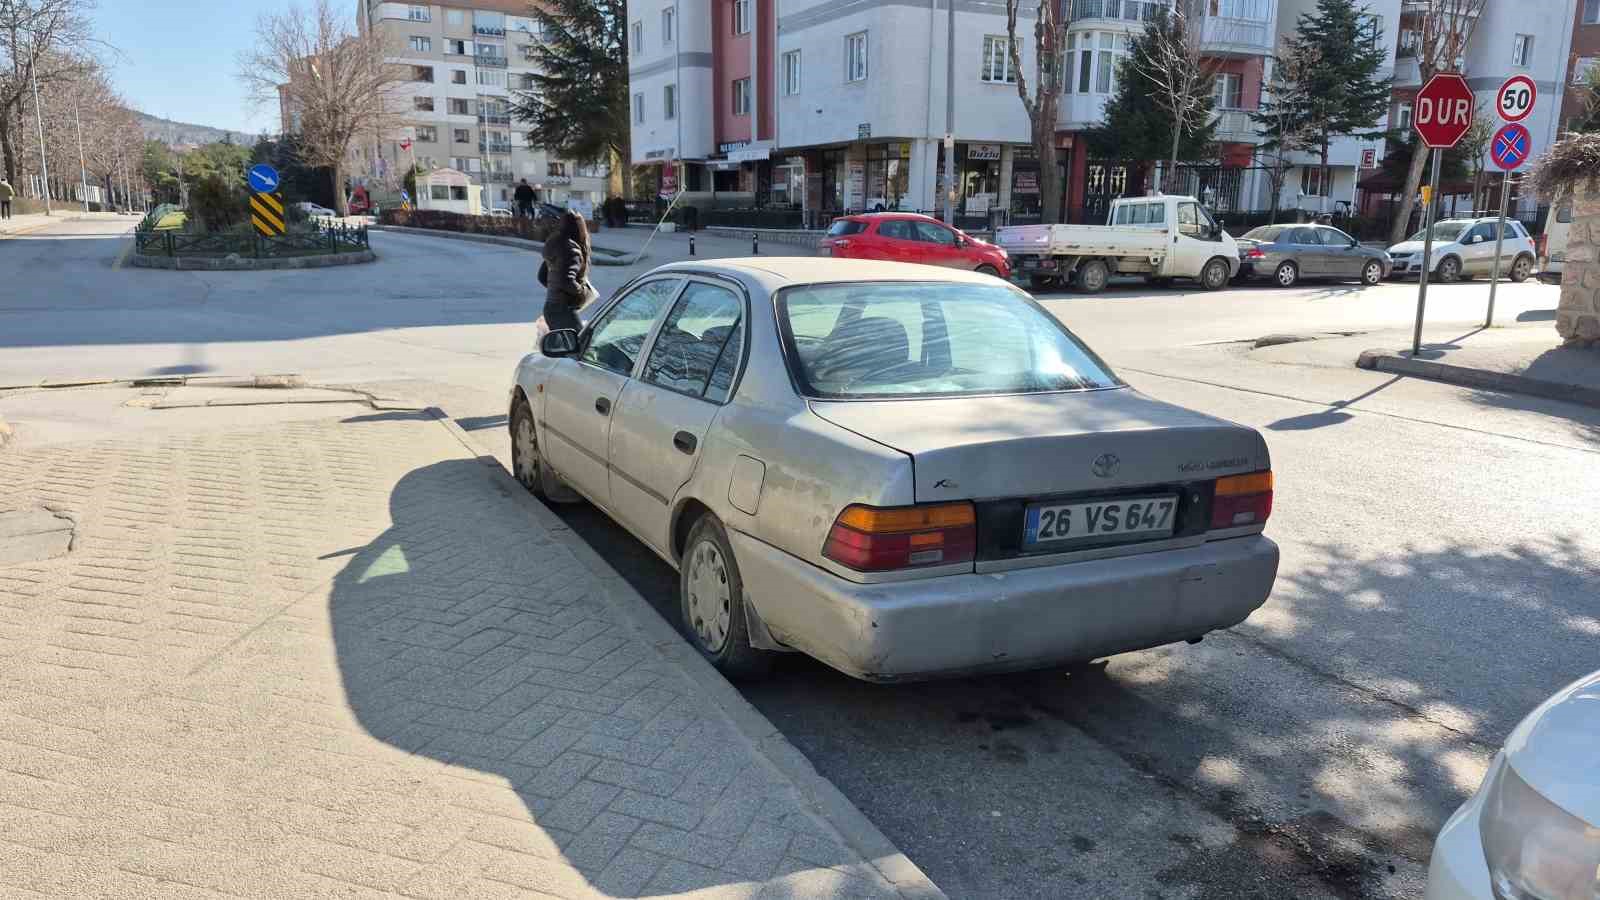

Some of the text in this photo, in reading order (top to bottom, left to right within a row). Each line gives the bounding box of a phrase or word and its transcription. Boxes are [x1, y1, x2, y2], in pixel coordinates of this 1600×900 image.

[1418, 97, 1469, 125] DUR
[1503, 89, 1530, 110] 50
[1038, 501, 1173, 539] 26 VS 647
